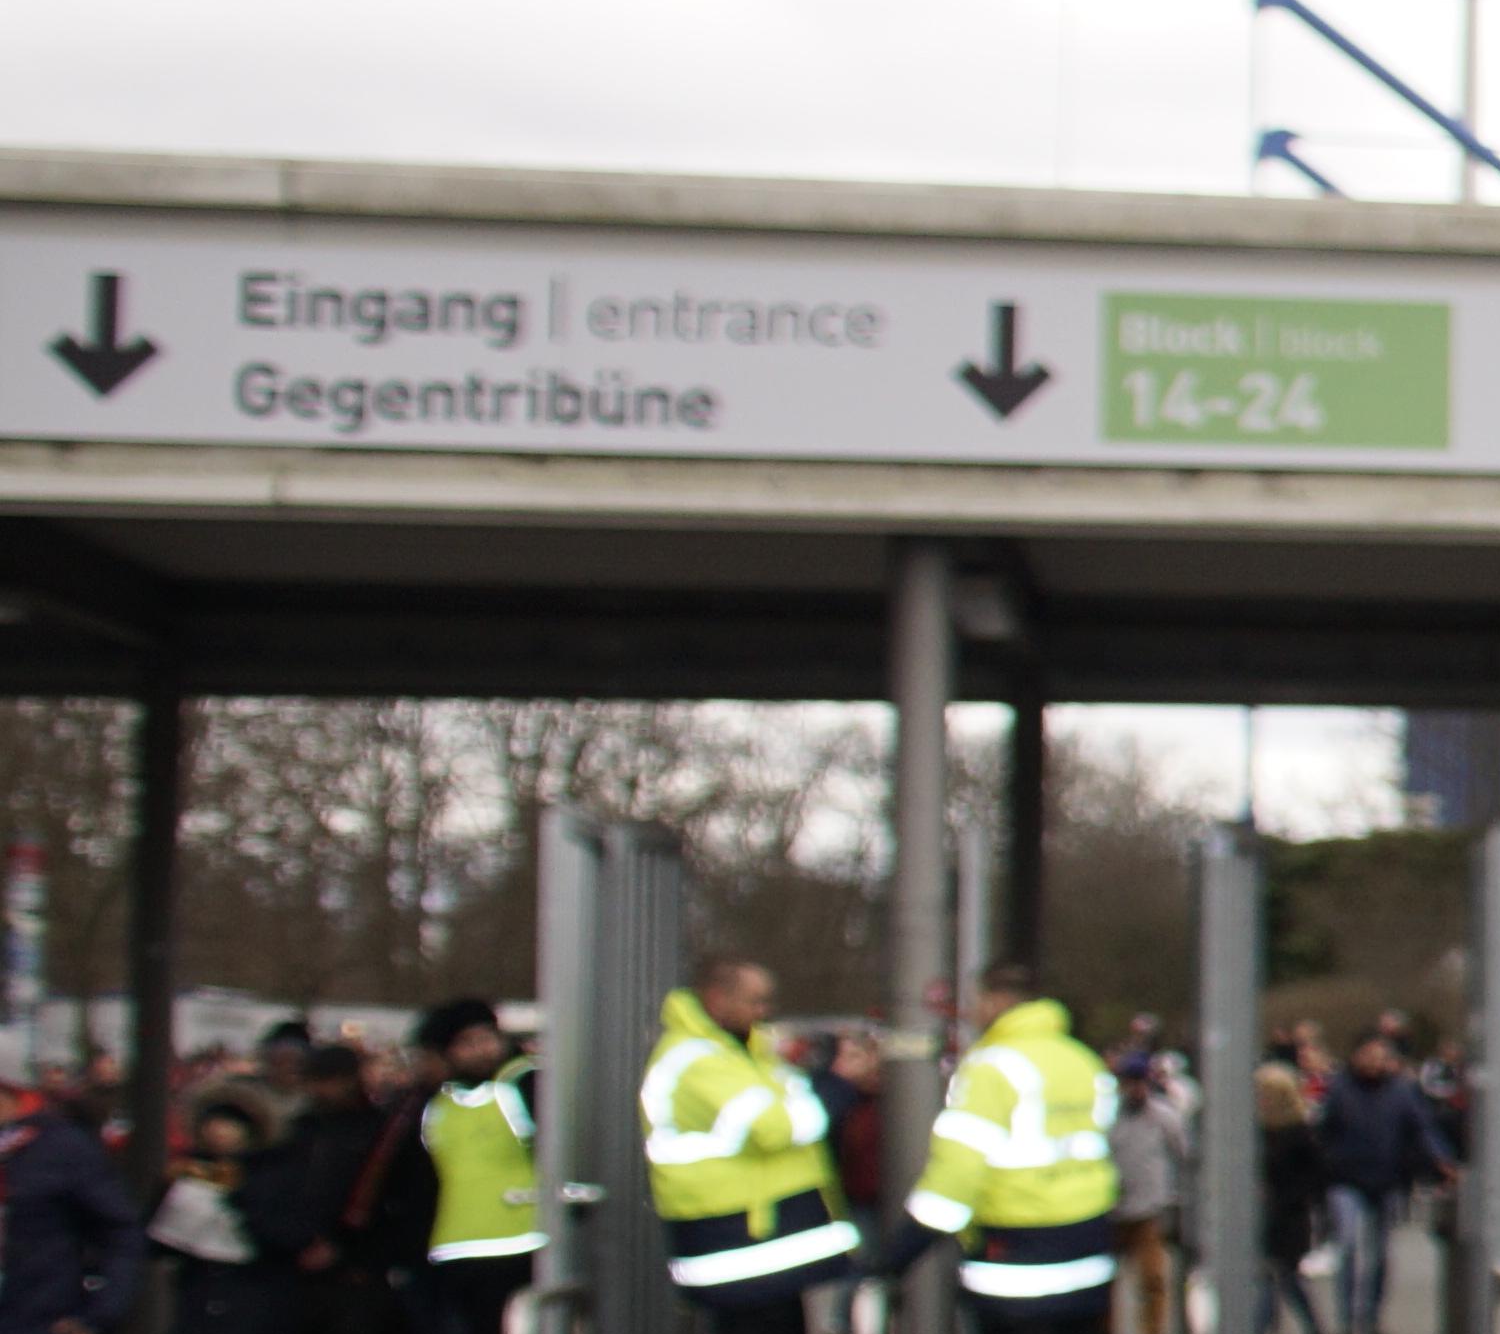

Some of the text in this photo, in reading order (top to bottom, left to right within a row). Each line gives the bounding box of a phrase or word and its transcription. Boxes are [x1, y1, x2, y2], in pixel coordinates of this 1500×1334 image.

[236, 270, 882, 345] Eingang entrance
[1120, 313, 1379, 359] Block block
[234, 363, 717, 432] Gegentribüne
[1122, 371, 1323, 431] 14-24
